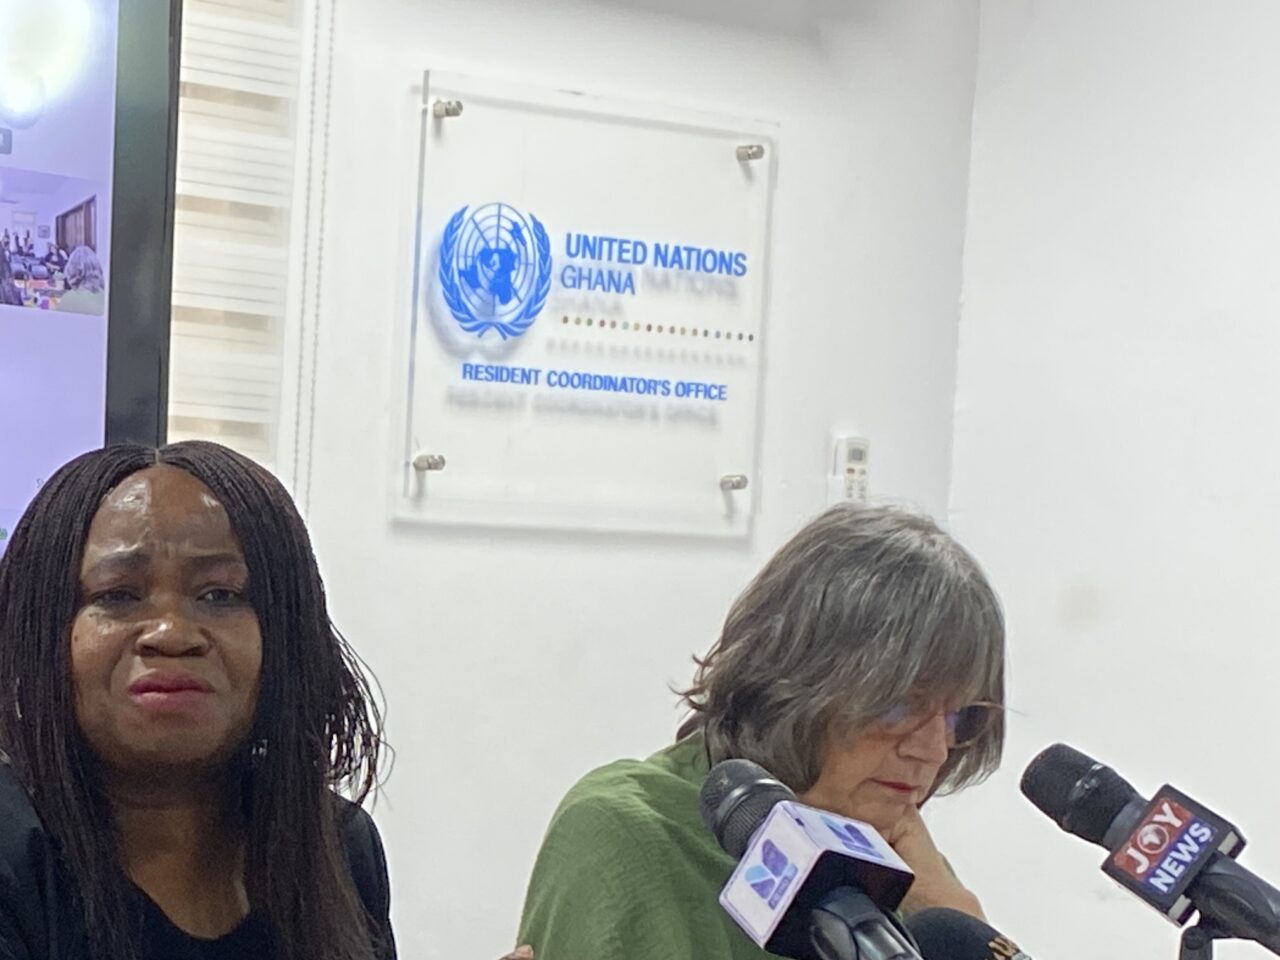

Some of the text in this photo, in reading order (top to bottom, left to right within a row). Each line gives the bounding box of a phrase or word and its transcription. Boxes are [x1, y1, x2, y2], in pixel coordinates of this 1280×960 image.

[565, 233, 748, 277] UNITED NATIONS
[560, 265, 636, 296] GHANA
[462, 362, 728, 401] RESIDENT COORDINATOR'S OFFICE
[1127, 802, 1183, 874] JOY
[1149, 823, 1212, 893] NEWS
